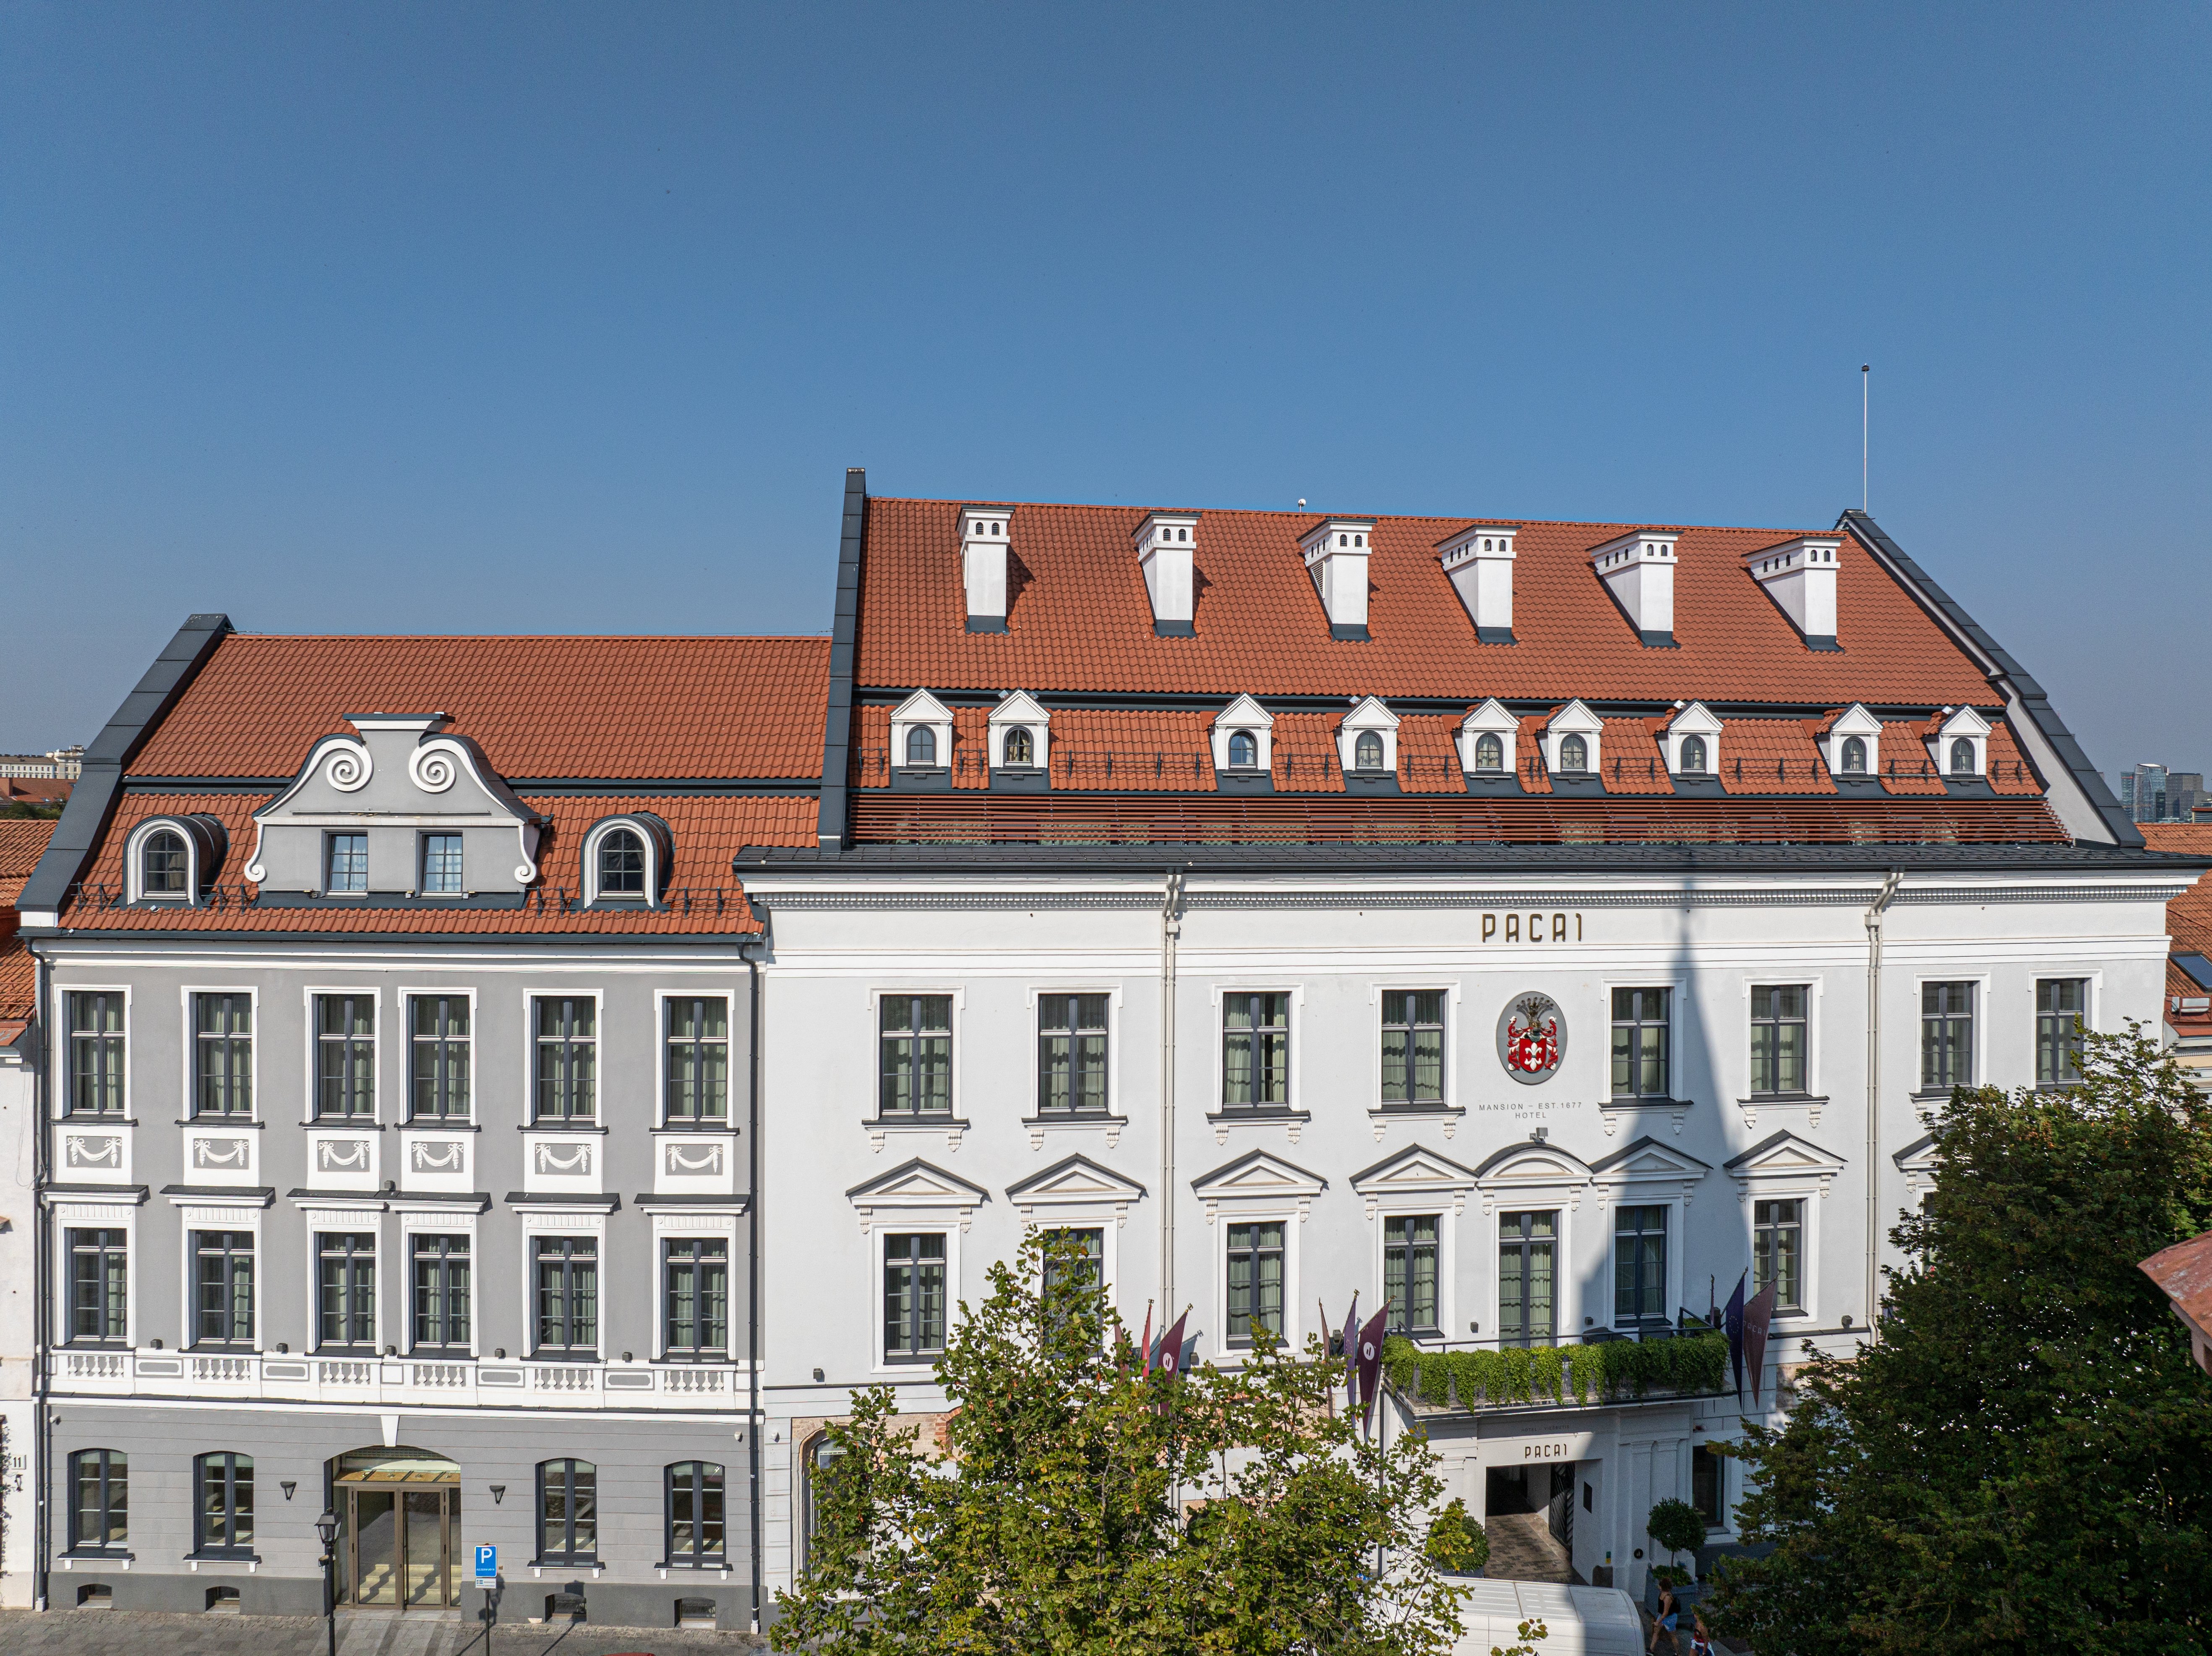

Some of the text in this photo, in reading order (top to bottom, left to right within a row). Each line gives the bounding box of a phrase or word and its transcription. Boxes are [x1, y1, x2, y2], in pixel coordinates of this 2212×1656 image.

[1482, 913, 1582, 943] PACAI
[1525, 1444, 1567, 1458] PACAI
[13, 1457, 21, 1468] 11
[481, 1548, 493, 1564] P
